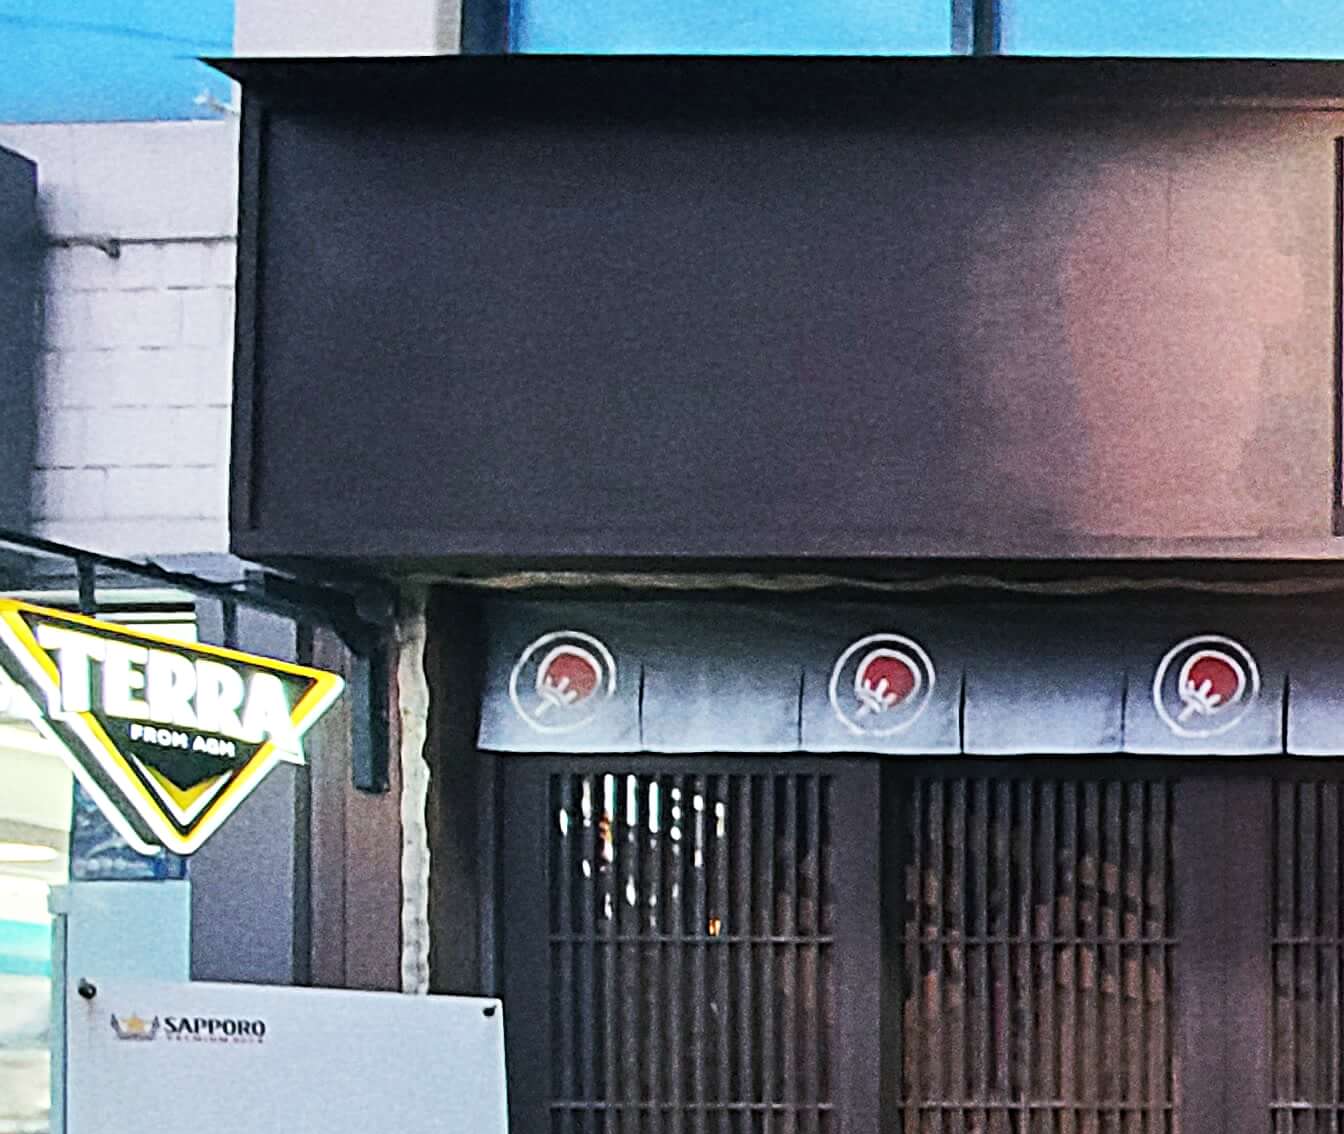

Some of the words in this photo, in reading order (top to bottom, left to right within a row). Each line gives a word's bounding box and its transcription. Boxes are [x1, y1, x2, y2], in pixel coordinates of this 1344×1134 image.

[35, 624, 305, 764] TERRA
[129, 723, 189, 750] FROM
[164, 1015, 266, 1037] SAPPORO
